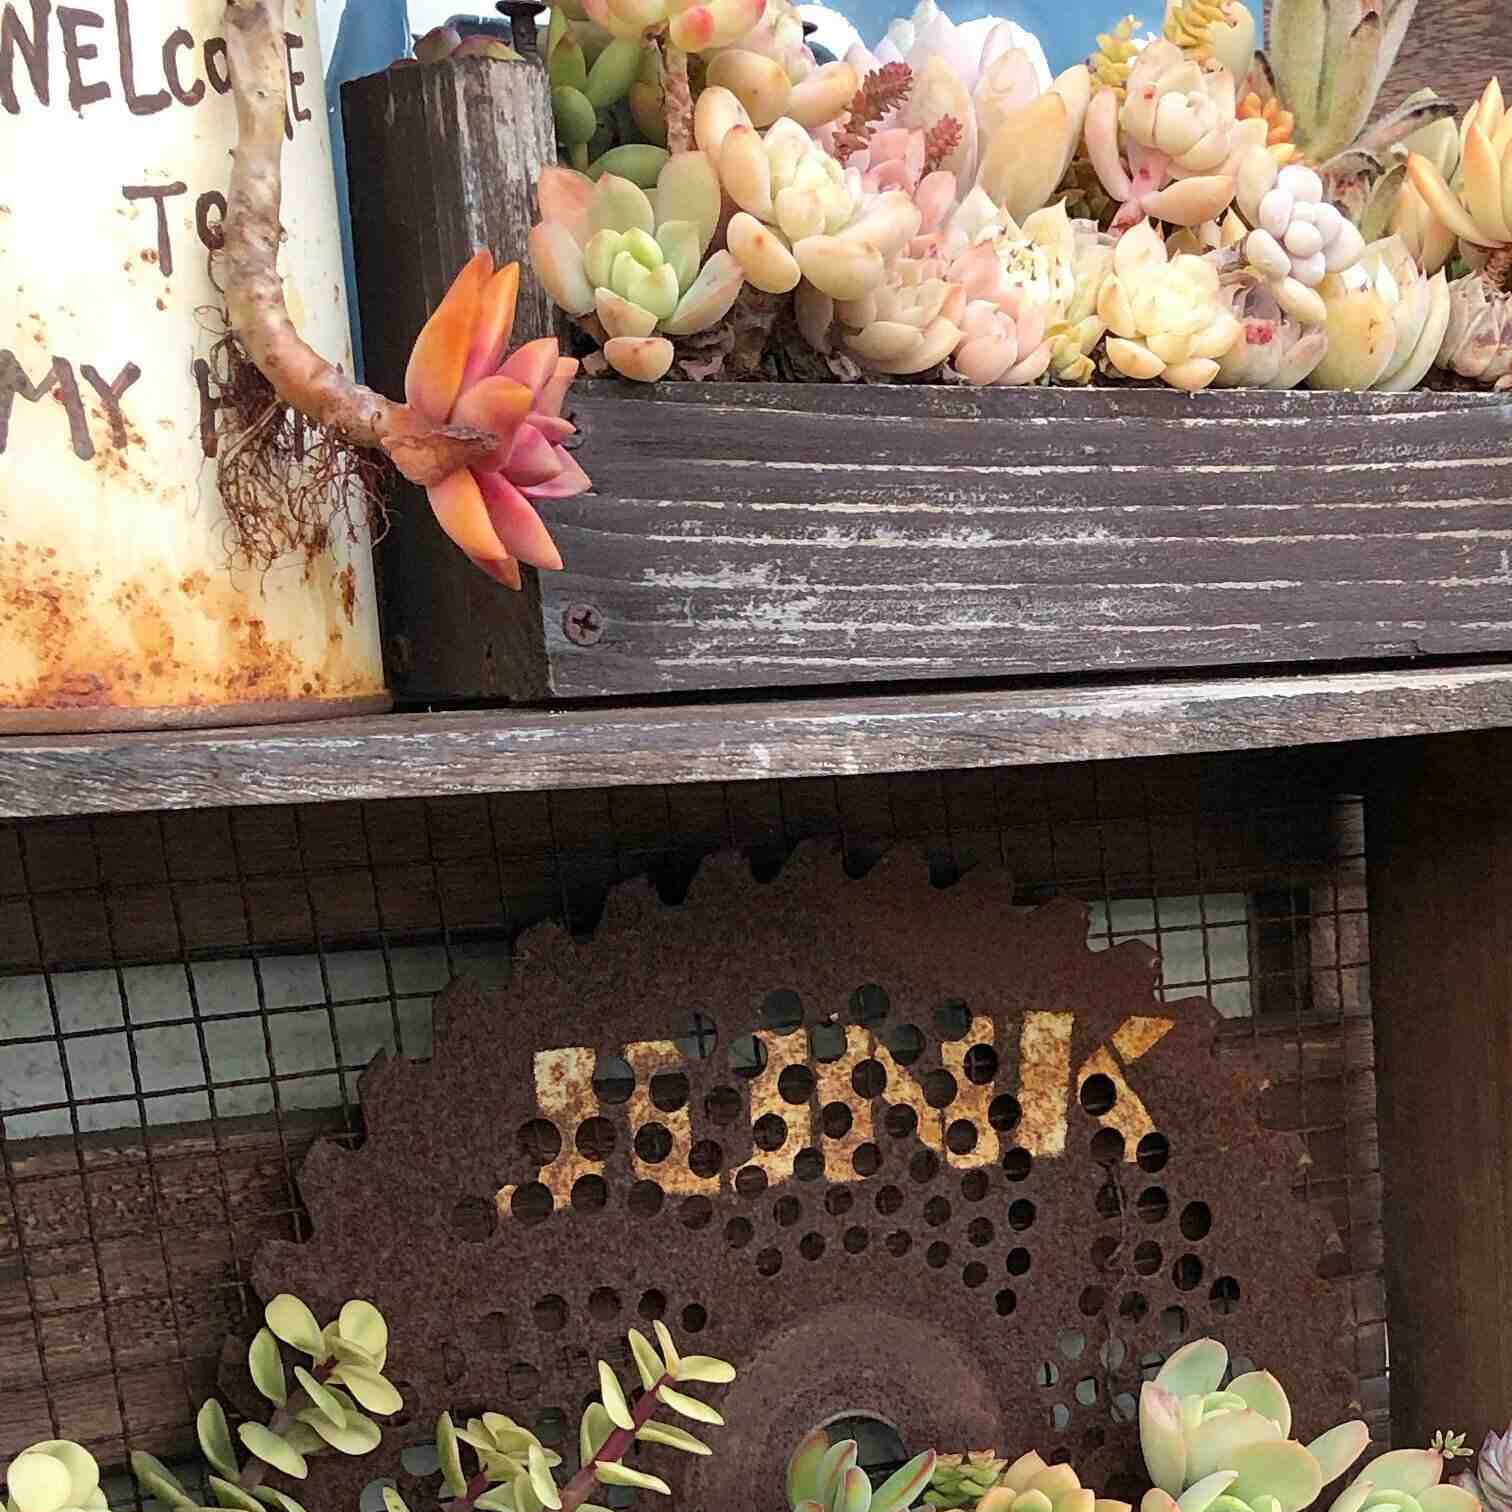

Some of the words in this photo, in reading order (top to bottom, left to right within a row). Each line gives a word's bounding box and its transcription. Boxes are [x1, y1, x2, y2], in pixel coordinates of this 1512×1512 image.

[0, 0, 312, 141] WELCOE
[122, 181, 227, 277] TO
[0, 349, 142, 462] MY
